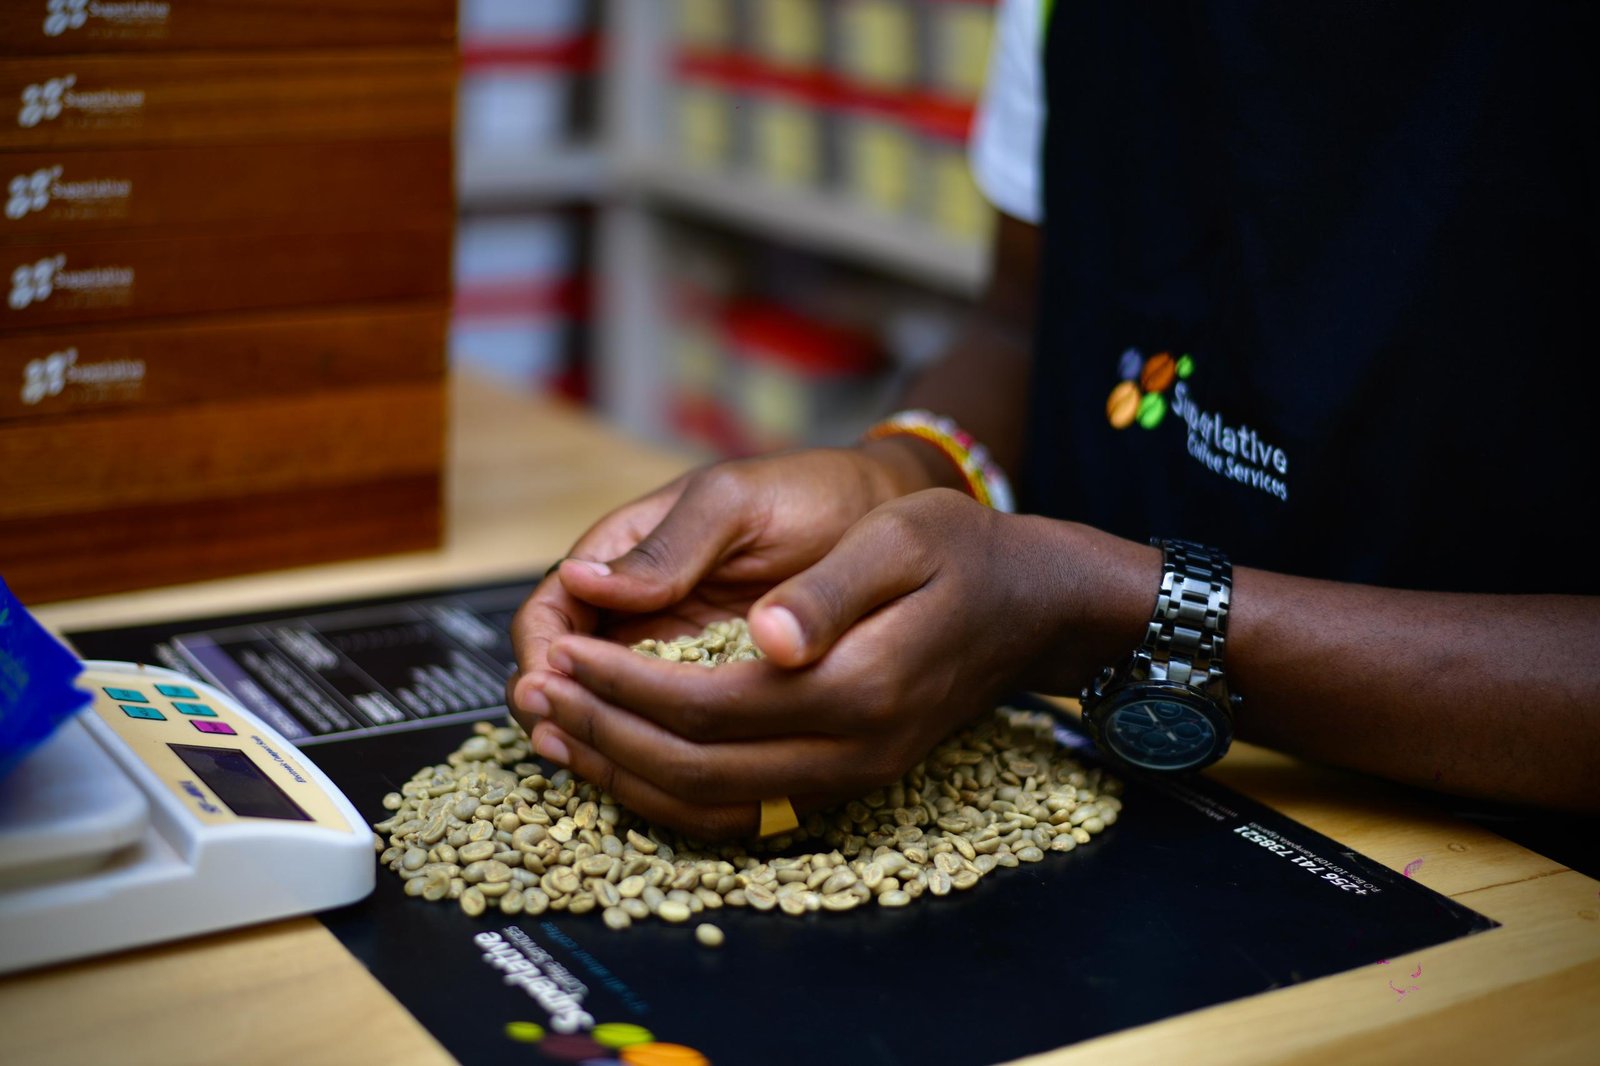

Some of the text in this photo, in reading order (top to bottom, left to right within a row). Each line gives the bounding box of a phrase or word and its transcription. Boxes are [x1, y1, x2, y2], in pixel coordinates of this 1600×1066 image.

[1171, 380, 1288, 474] Superlative
[1224, 455, 1288, 501] Services
[1233, 825, 1367, 895] +256 741 738521
[1348, 873, 1365, 885] Box
[502, 925, 554, 966] Services
[474, 931, 595, 1034] Superlative
